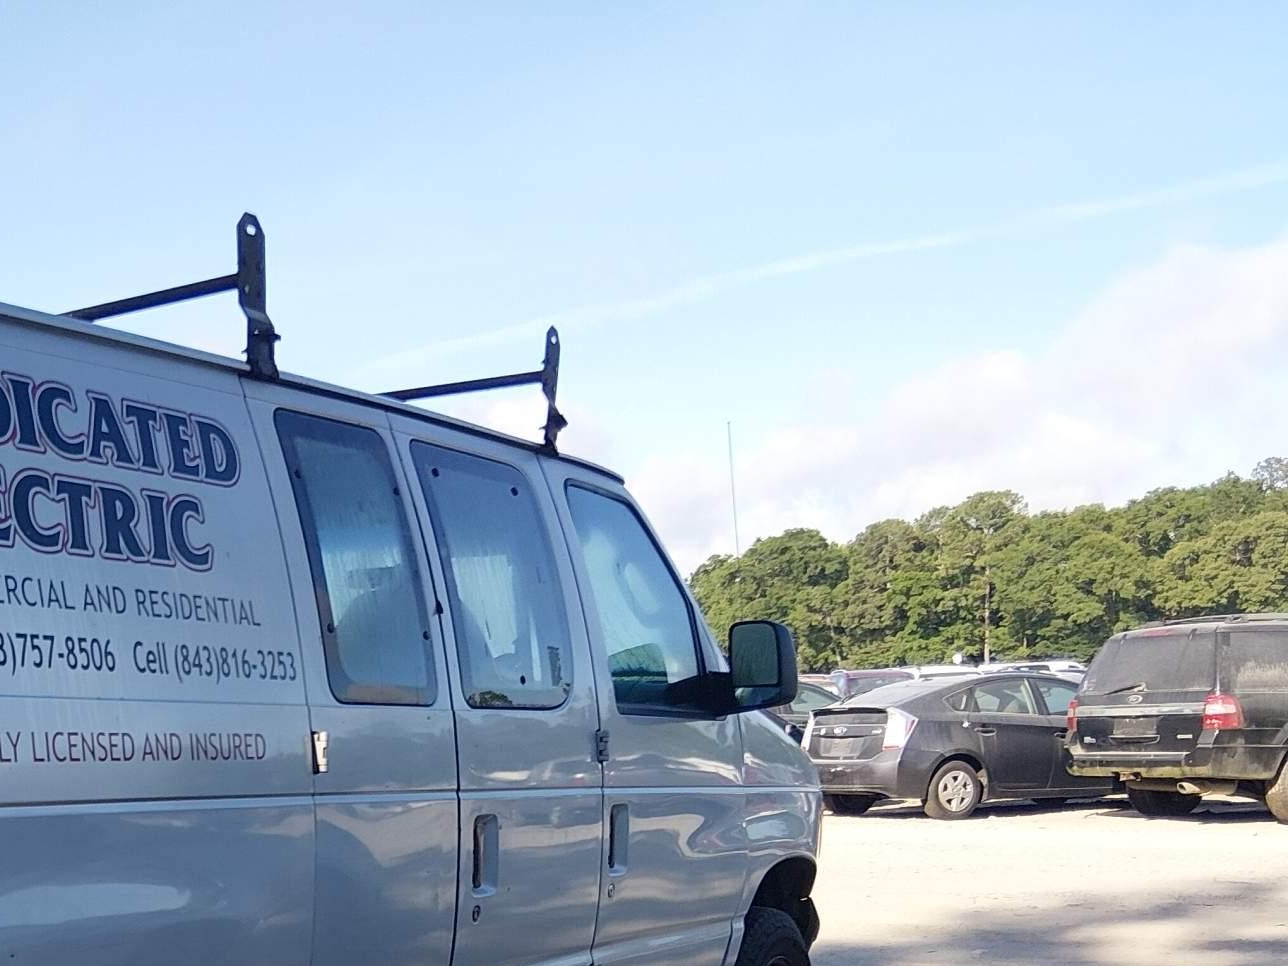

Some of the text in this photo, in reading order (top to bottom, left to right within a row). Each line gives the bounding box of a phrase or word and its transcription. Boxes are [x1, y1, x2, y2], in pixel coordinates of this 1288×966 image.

[83, 584, 127, 614] AND
[134, 588, 261, 626] RESIDENTIAL
[133, 641, 169, 674] Cell
[174, 644, 297, 684] (843)816-3253
[31, 732, 135, 762] LICENSED
[142, 732, 182, 761] AND
[189, 732, 267, 761] INSURED
